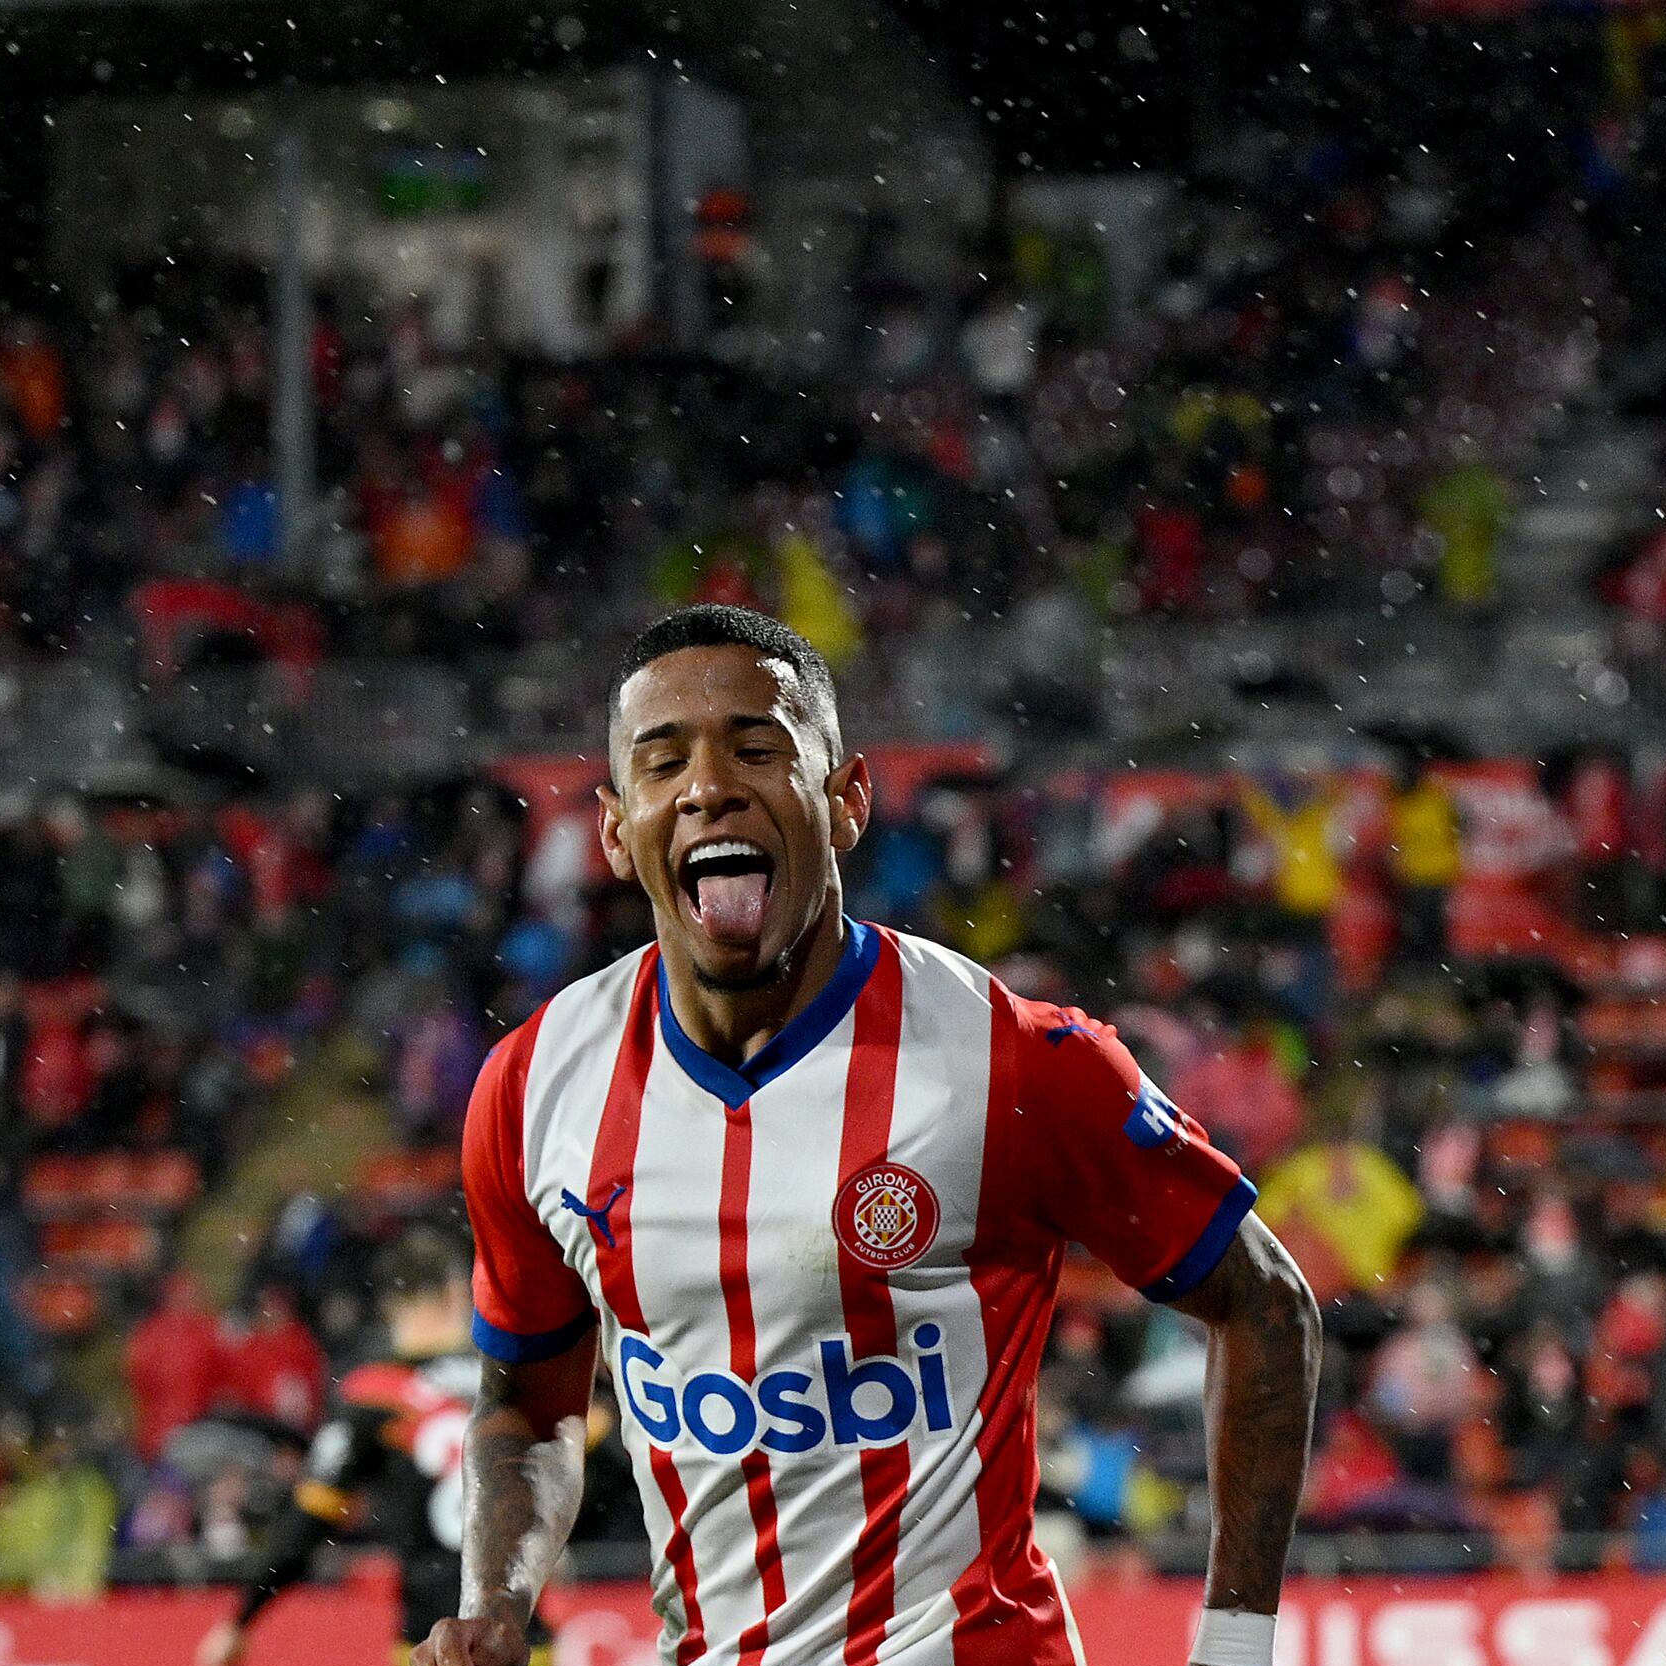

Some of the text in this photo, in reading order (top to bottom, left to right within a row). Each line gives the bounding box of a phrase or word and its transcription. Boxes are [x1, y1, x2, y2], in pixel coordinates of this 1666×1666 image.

[855, 1172, 918, 1198] GIRONA
[854, 1240, 916, 1260] FUTBOL CLUB
[620, 1323, 953, 1455] Gosbi
